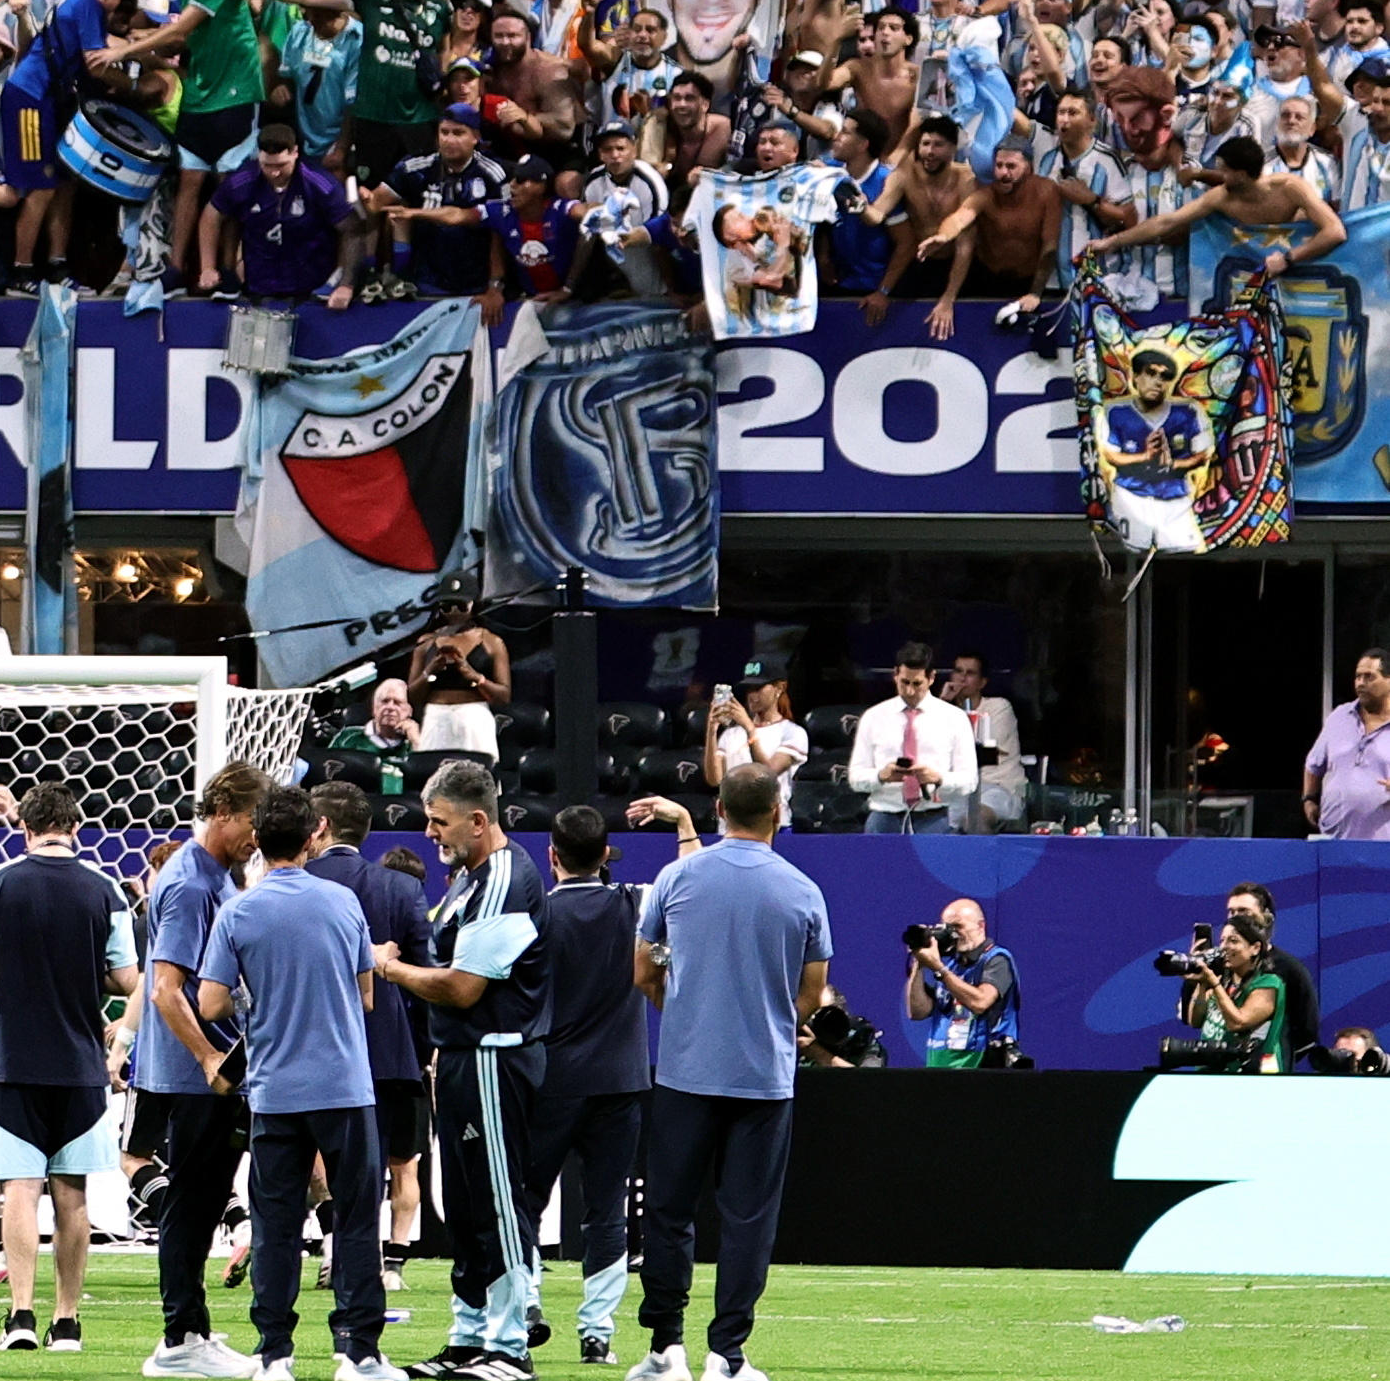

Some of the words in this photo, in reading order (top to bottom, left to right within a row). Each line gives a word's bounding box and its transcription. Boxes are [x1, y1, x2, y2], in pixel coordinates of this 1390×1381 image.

[303, 65, 324, 105] 7
[92, 152, 124, 181] 10
[266, 222, 283, 246] 4
[373, 363, 456, 439] COLON
[717, 346, 1081, 477] 202
